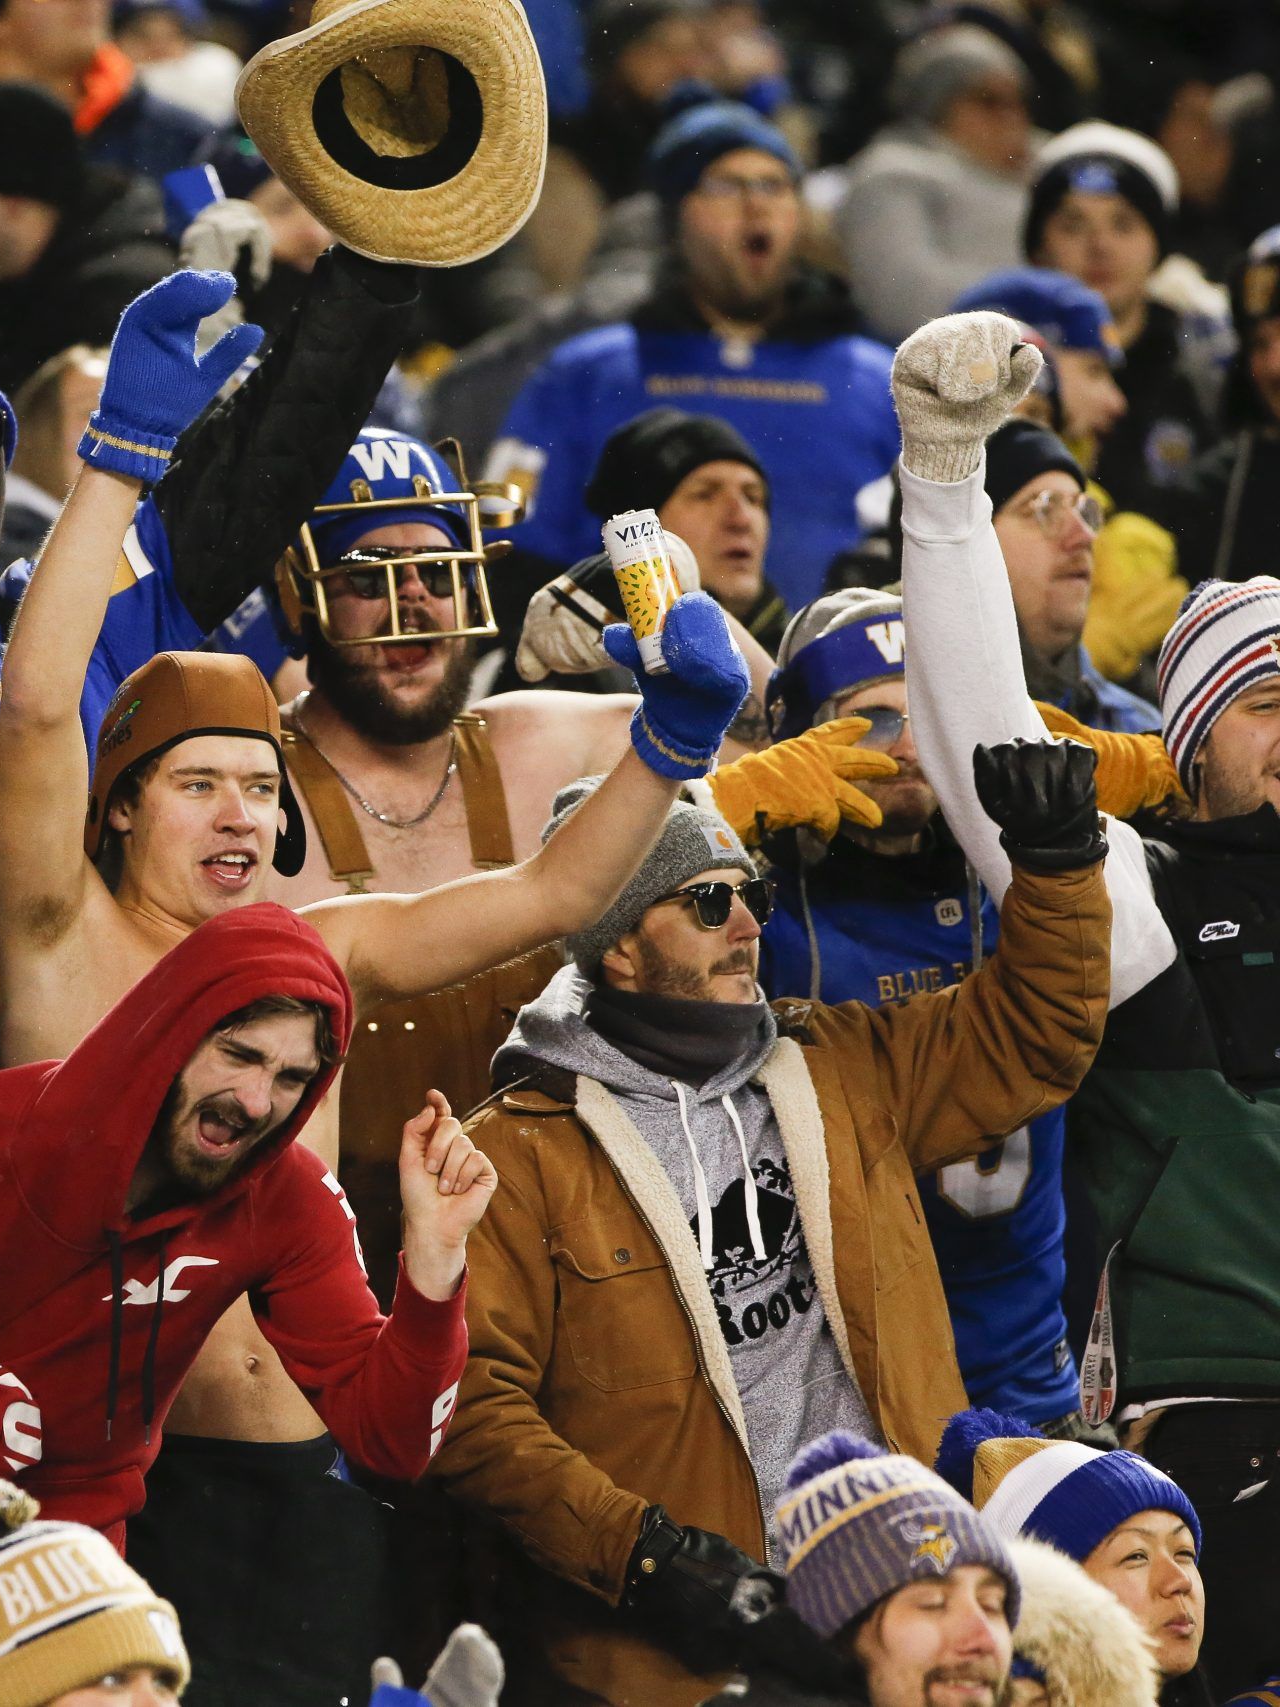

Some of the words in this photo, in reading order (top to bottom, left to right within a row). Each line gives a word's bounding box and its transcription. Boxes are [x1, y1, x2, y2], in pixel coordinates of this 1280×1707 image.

[348, 440, 412, 481] W
[939, 905, 959, 919] CFL
[876, 966, 942, 1000] BLUE
[714, 1274, 816, 1346] Root
